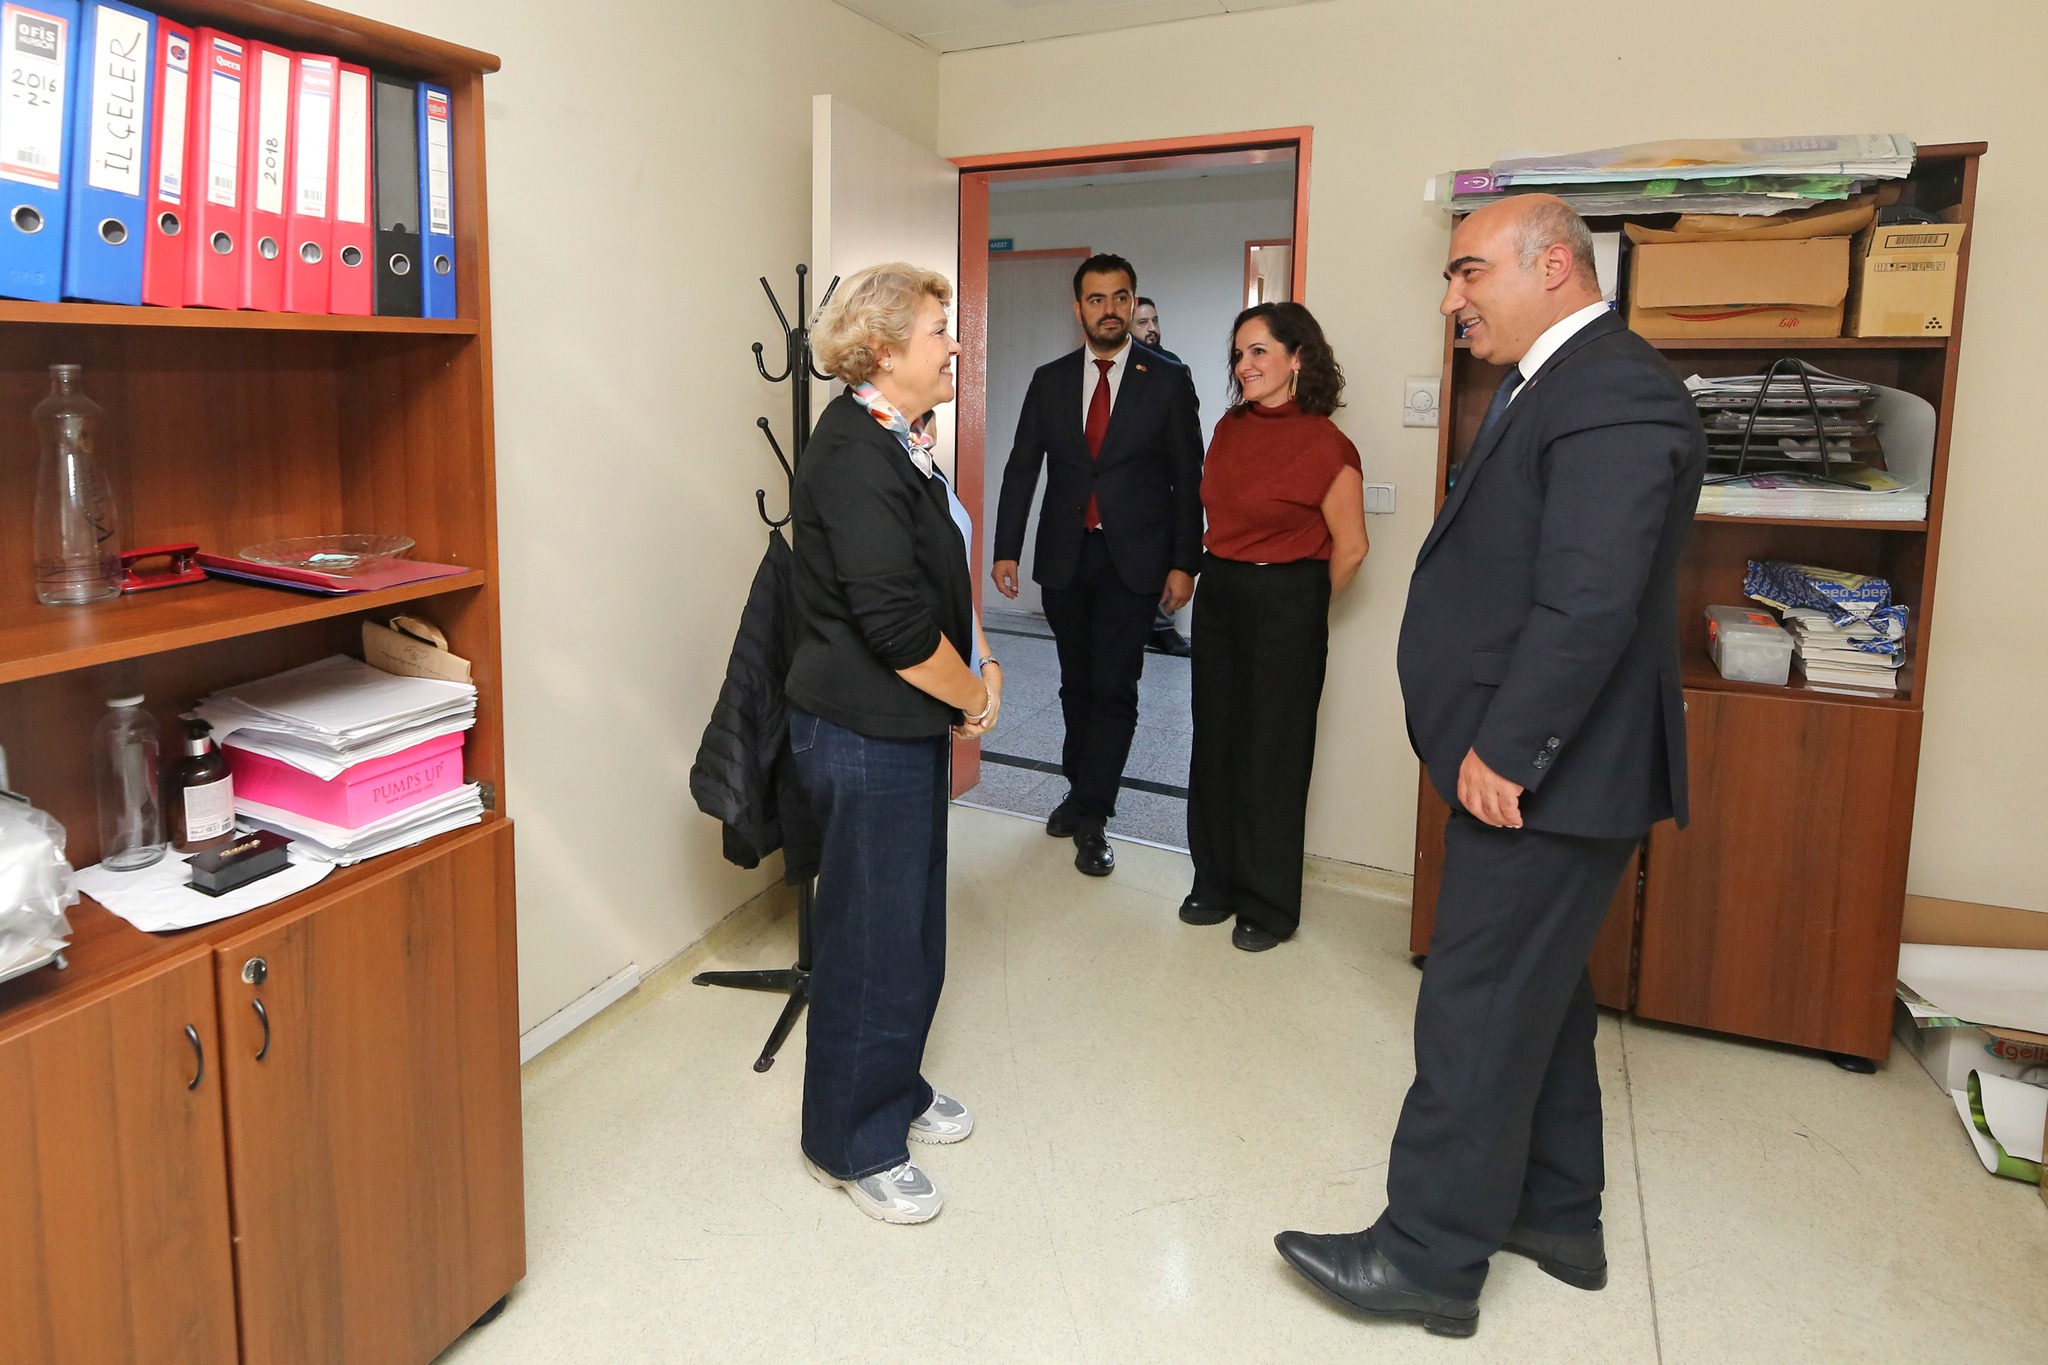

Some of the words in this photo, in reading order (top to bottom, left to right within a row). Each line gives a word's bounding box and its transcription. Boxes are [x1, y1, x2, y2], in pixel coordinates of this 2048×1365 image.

[11, 68, 57, 93] 2016
[216, 55, 242, 71] Queen
[96, 32, 141, 174] İLÇELER
[264, 137, 279, 186] 2018
[373, 773, 421, 801] PUMPS
[425, 764, 443, 782] UP
